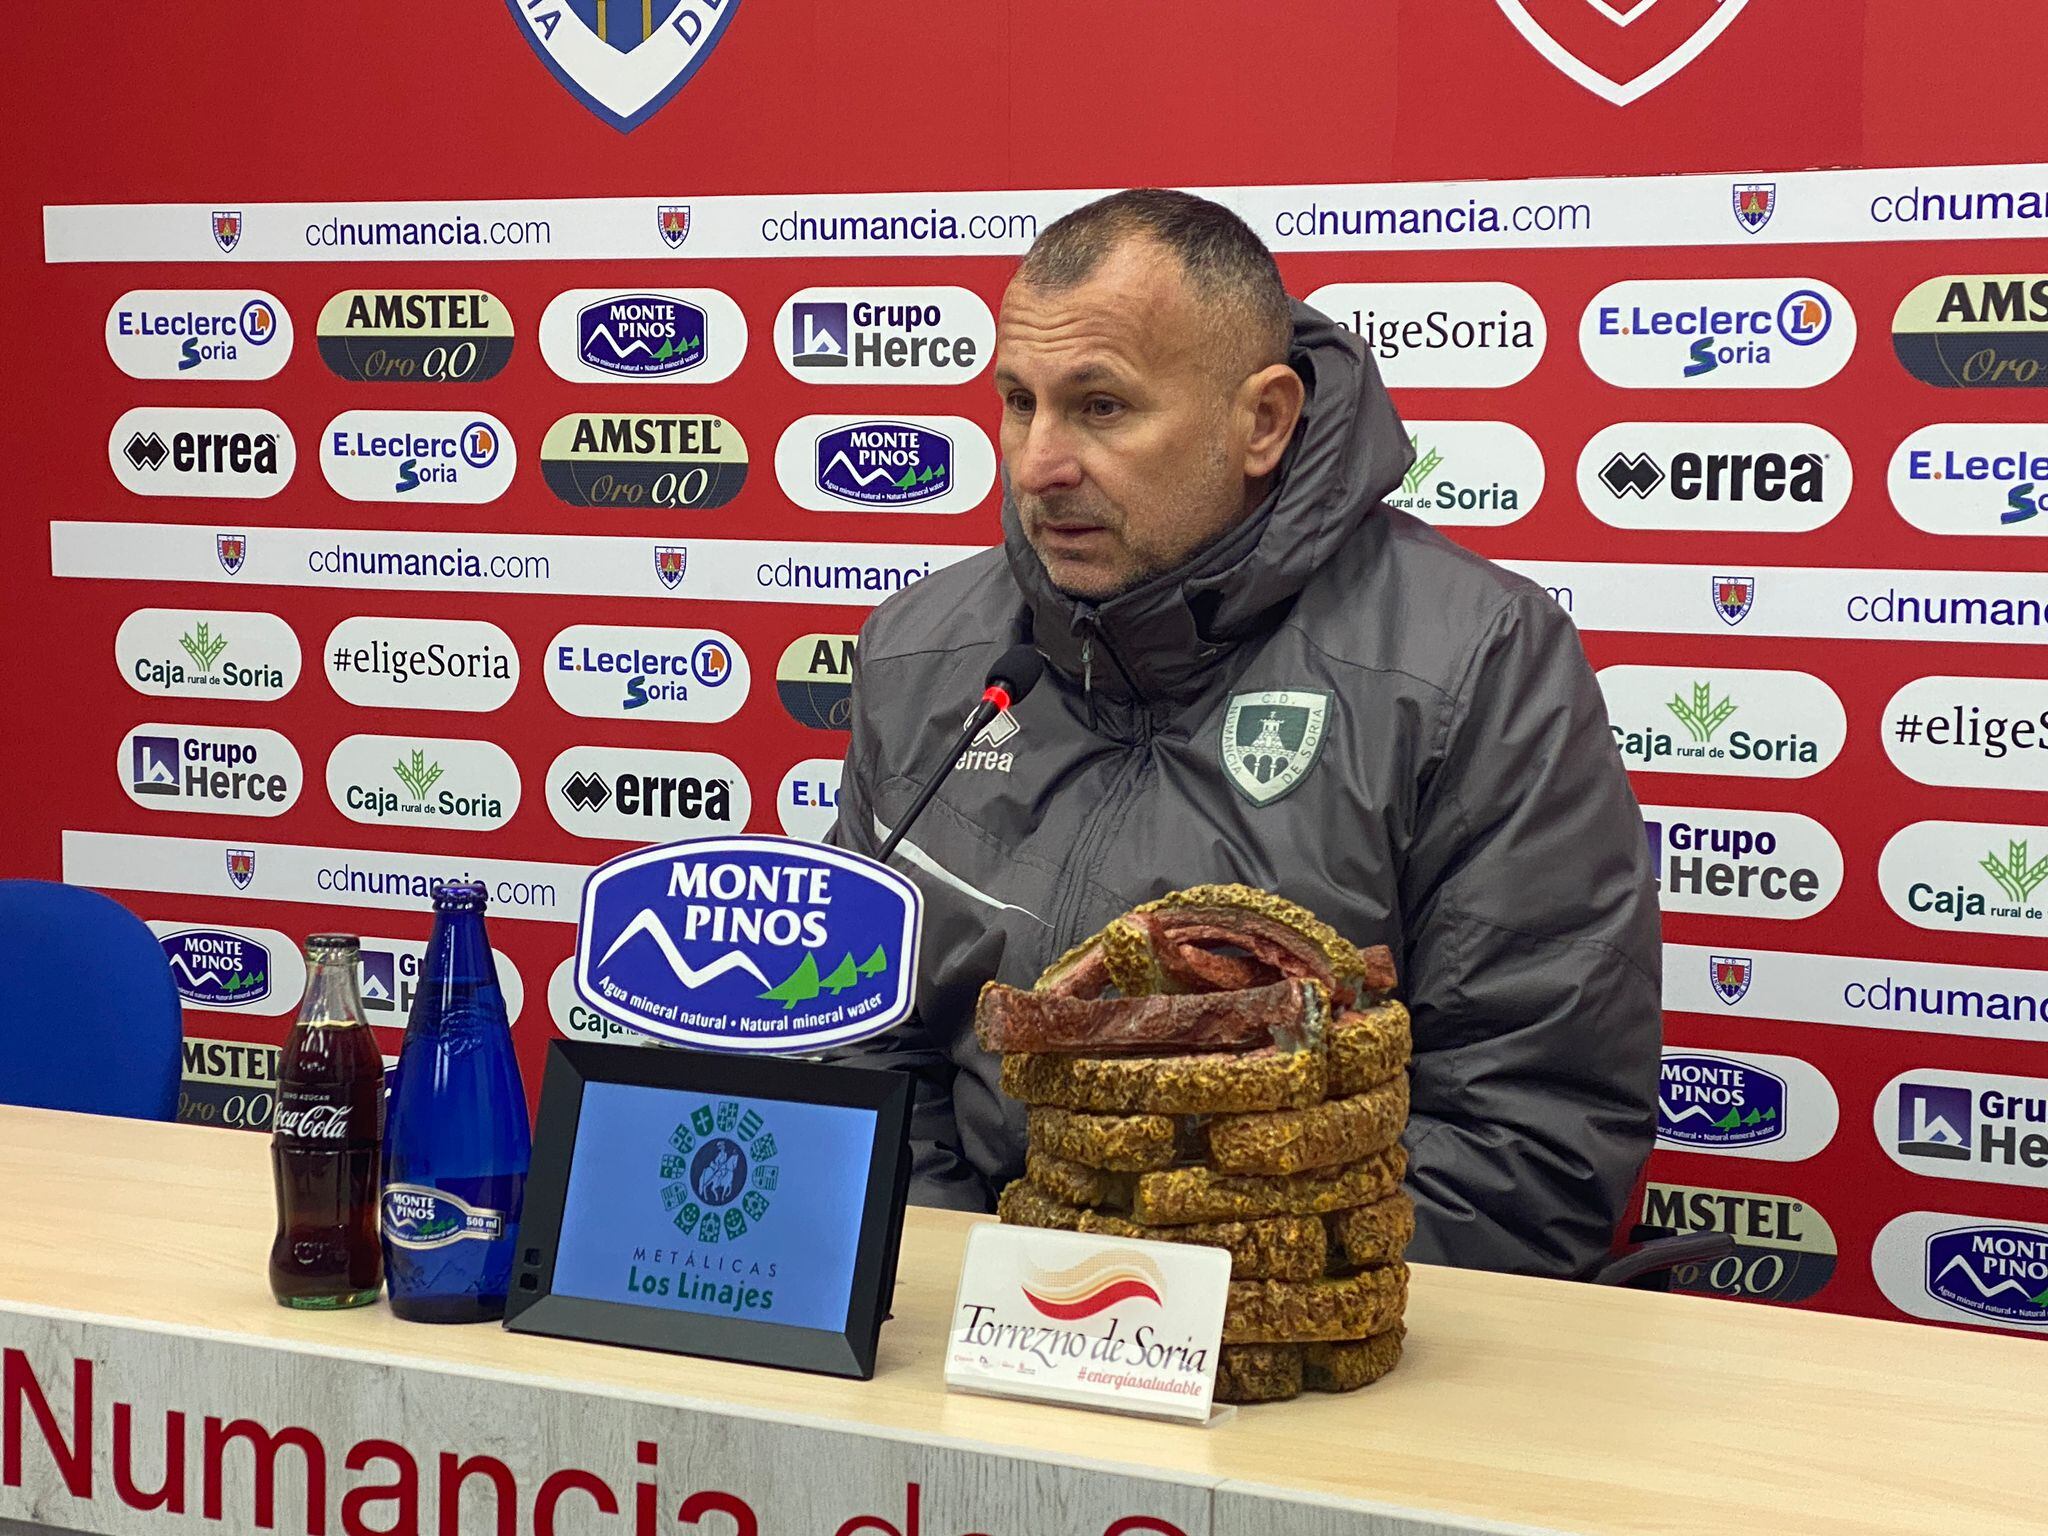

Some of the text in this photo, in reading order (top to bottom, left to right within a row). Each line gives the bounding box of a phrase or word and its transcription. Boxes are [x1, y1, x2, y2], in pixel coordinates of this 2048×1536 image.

[1276, 199, 1592, 236] cdnumancia.com
[1871, 186, 2048, 222] cdnuma
[305, 217, 551, 247] cdnumancia.com
[762, 208, 1037, 242] cdnumancia.com
[118, 311, 237, 336] E.Leclerc
[345, 294, 489, 329] AMSTEL
[610, 304, 675, 321] MONTE
[853, 302, 941, 332] Grupo
[1599, 306, 1772, 336] E.Leclerc
[618, 322, 676, 338] PINOS
[178, 336, 237, 371] Soria
[364, 341, 477, 382] Oro 0,0
[855, 332, 976, 368] Herce
[1684, 336, 1771, 377] Soria
[1962, 348, 2040, 382] Oro
[333, 432, 457, 458] E.Leclerc
[570, 418, 722, 455] AMSTEL
[850, 432, 920, 448] MONTE
[859, 450, 920, 466] PINOS
[396, 459, 457, 493] Soria
[590, 468, 708, 508] Oro 0,0
[1417, 498, 1431, 509] de
[1436, 481, 1518, 510] Soria
[309, 545, 550, 579] cdnumancia.com
[757, 557, 929, 591] cdnumanci
[1847, 588, 2048, 626] cdnuman
[135, 658, 283, 689] Caja rural de Soria
[333, 640, 511, 683] #eligeSoria
[558, 646, 688, 676] E.Leclerc
[623, 675, 688, 710] Soria
[184, 738, 256, 768] Grupo
[1224, 705, 1242, 774] NUMANCIA
[1281, 708, 1324, 785] DE SORIA
[1677, 746, 1705, 758] rural
[1708, 746, 1724, 759] de
[1729, 731, 1817, 763] Soria
[185, 765, 287, 802] Herce
[346, 785, 501, 818] Caja rural de Soria
[1668, 823, 1776, 860] Grupo
[667, 862, 832, 905] MONTE
[1670, 855, 1819, 902] Herce
[1908, 882, 2042, 922] Caja rural de
[684, 905, 828, 948] PINOS
[184, 938, 243, 956] MONTE
[192, 954, 243, 971] PINOS
[599, 975, 884, 1032] Agua mineral natural Natural mineral water
[1660, 1064, 1745, 1088] MONTE
[1671, 1084, 1745, 1106] PINOS
[393, 1193, 435, 1209] MONTE
[396, 1205, 435, 1221] PINOS
[1645, 1188, 1803, 1241] MSTEL
[466, 1216, 497, 1229] 500 ml
[633, 1247, 777, 1278] METÁLICAS
[1710, 1254, 1784, 1296] 0,0
[628, 1265, 773, 1312] Los Linajes
[1938, 1285, 1956, 1299] Agua
[1956, 1293, 1984, 1309] mineral
[1985, 1304, 2012, 1315] natural
[958, 1304, 1208, 1373] Torrezno de Soria
